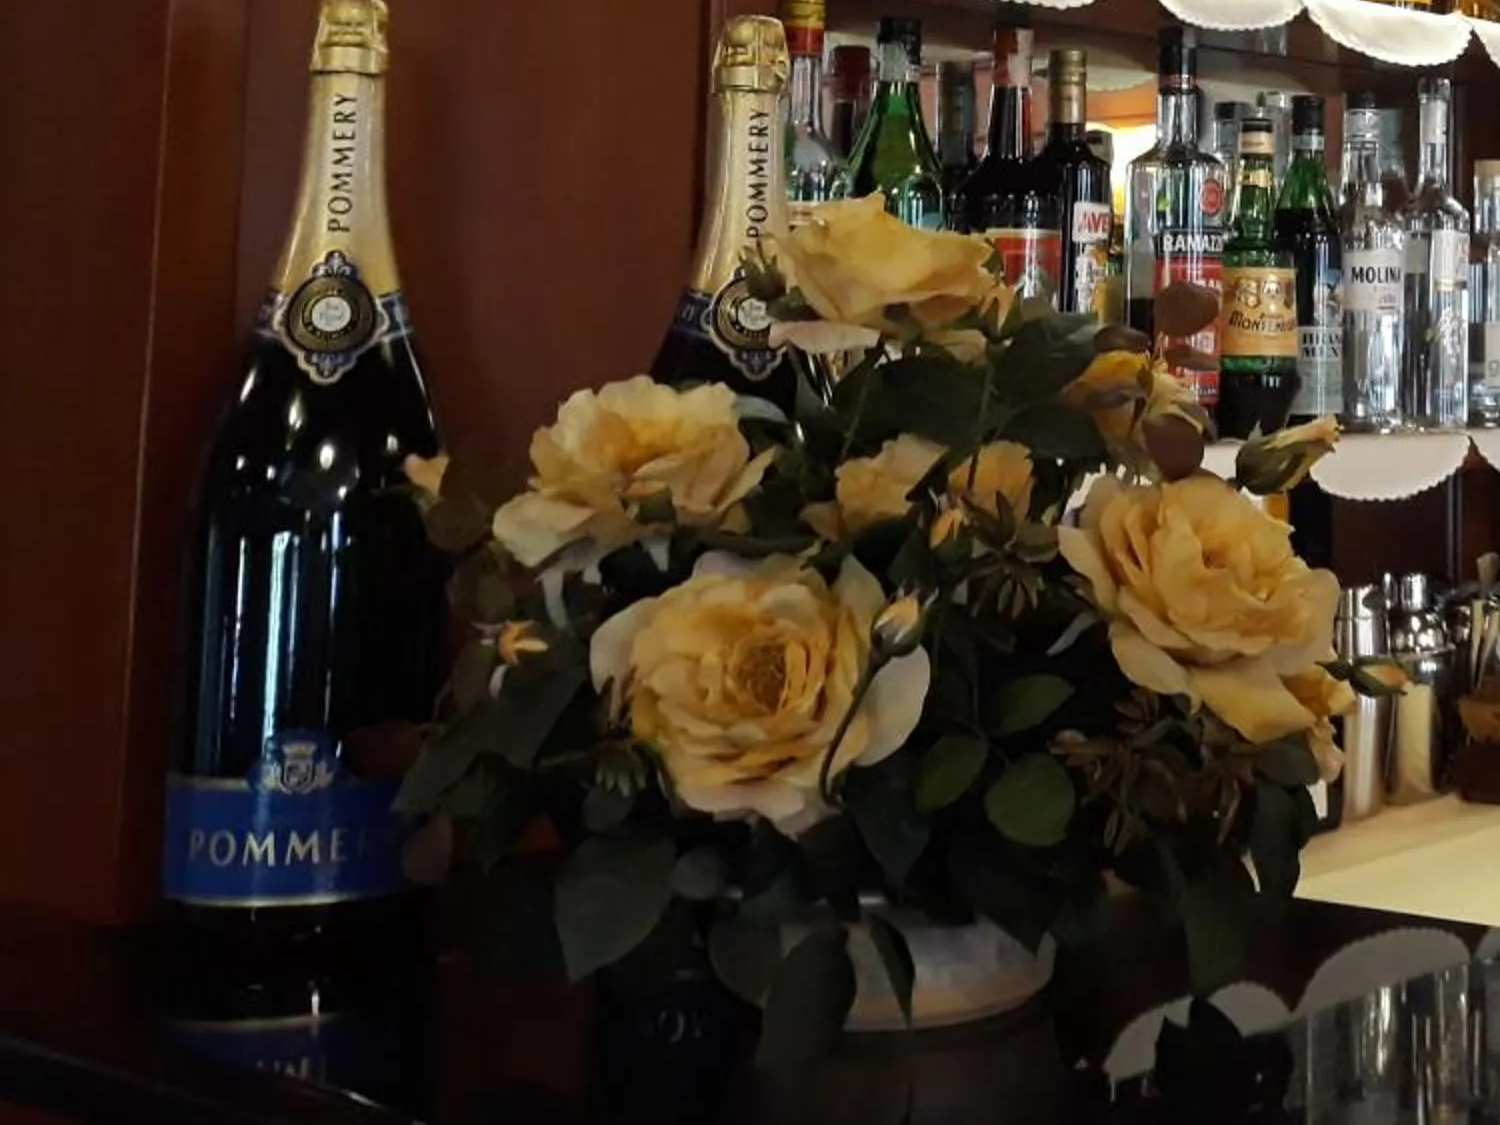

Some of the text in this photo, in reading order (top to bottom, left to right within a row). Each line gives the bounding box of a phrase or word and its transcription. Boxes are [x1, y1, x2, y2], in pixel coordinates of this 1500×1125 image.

[328, 93, 358, 233] POMMERY
[746, 108, 770, 239] POMMERY
[189, 826, 365, 868] POMME
